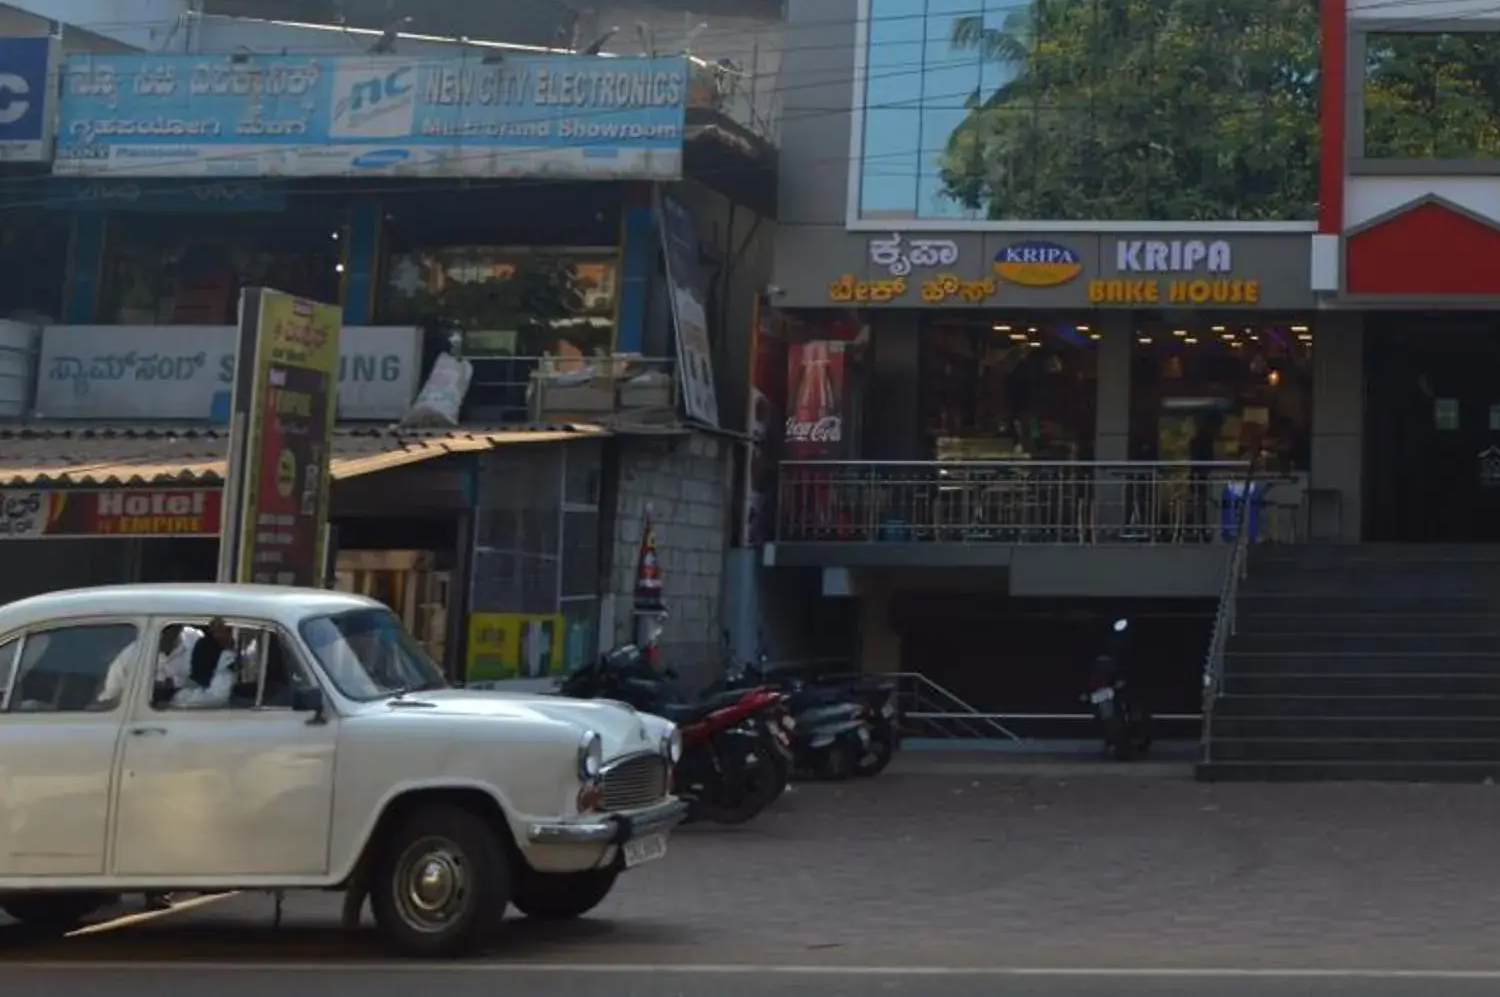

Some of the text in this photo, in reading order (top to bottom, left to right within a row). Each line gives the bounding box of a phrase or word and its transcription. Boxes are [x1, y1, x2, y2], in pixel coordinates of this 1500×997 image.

[426, 66, 683, 109] NEW CITY ELECTRONICS
[558, 119, 678, 139] Showroom
[869, 233, 959, 276] ಕೃಪಾ
[1006, 247, 1075, 264] KRIPA
[1116, 239, 1232, 272] KRIPA
[1088, 279, 1261, 303] BAKE HOUSE
[97, 490, 206, 516] Hotel
